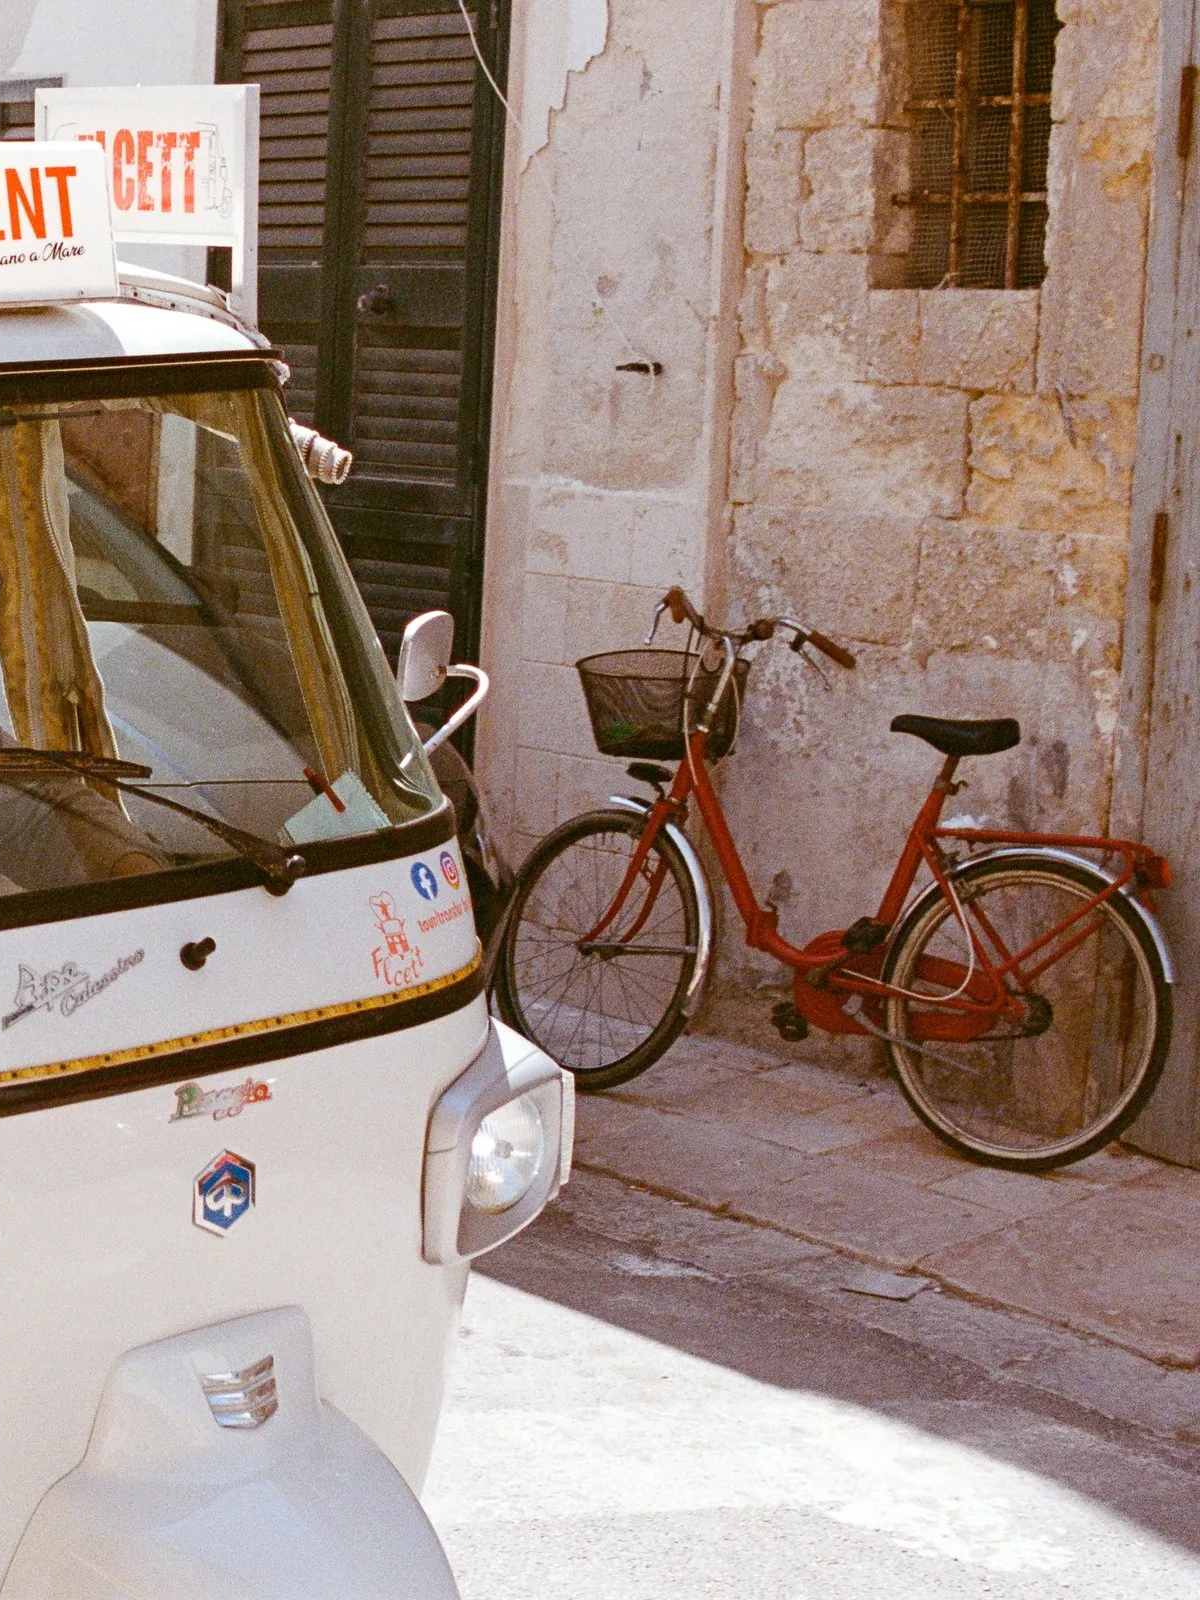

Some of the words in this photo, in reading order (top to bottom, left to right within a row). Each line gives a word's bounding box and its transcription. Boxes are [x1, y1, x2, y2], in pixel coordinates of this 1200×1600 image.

[78, 128, 201, 213] CETT
[29, 252, 40, 262] a
[42, 241, 86, 262] Mare
